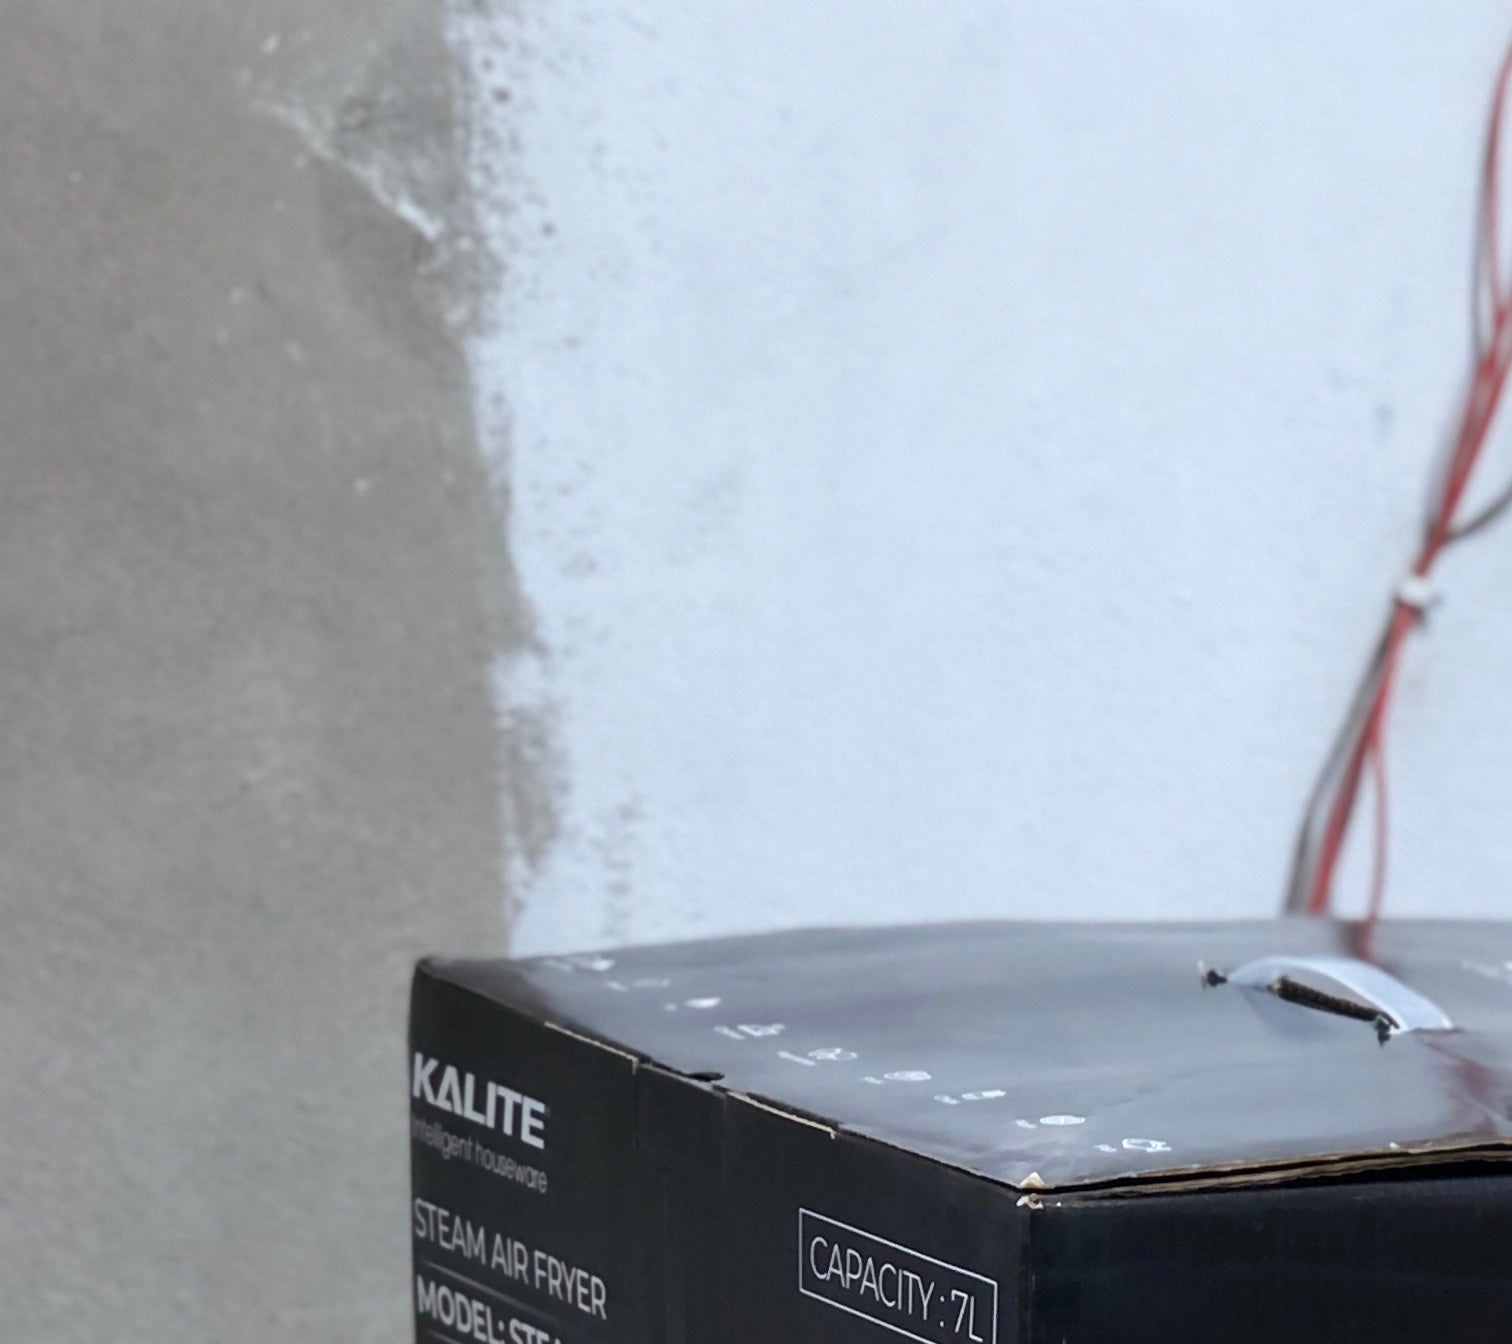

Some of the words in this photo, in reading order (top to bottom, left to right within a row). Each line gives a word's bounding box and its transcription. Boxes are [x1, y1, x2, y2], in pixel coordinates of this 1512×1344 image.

[412, 1051, 546, 1150] KALITE
[475, 1140, 548, 1194] houseware
[414, 1198, 487, 1266] STEAM
[491, 1233, 530, 1285] AIR
[534, 1250, 607, 1320] FRYER
[809, 1236, 935, 1320] CAPACITY
[950, 1289, 984, 1343] 7L
